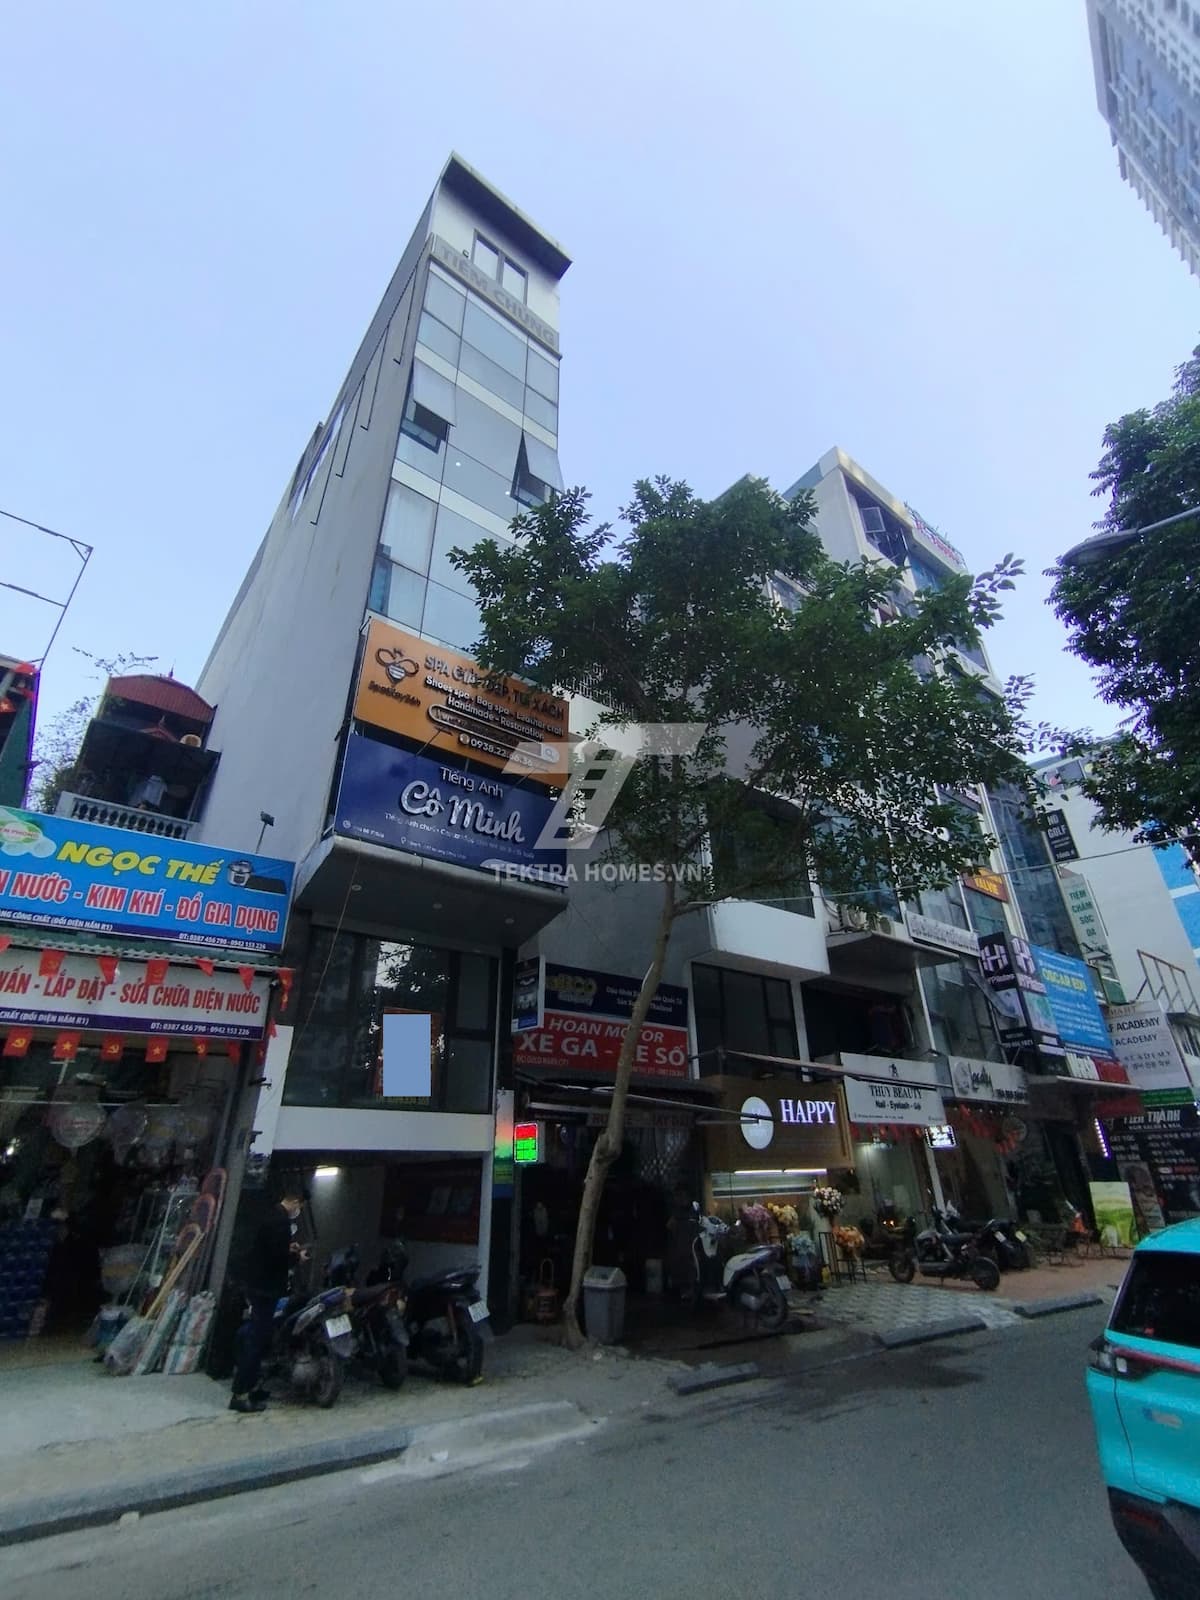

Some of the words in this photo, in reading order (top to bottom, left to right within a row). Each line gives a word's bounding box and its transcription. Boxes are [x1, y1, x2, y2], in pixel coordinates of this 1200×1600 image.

[425, 655, 449, 677] SPA
[425, 675, 452, 693] Shoes
[476, 695, 493, 710] Bag
[448, 695, 494, 720] Handmade
[500, 716, 545, 741] Restoration
[440, 766, 475, 792] Tiếng
[478, 781, 504, 798] Anh
[401, 780, 445, 816] Cô
[449, 795, 526, 843] Minh
[1047, 825, 1067, 839] GOLF
[57, 841, 162, 877] NGỌC
[165, 858, 225, 886] THẾ
[9, 872, 72, 904] NƯỚC
[84, 883, 128, 913] KIM
[128, 888, 167, 917] KHÍ
[204, 901, 233, 927] GIA
[235, 906, 280, 934] DỤNG
[0, 965, 32, 994] VẤN
[43, 968, 76, 998] LẮP
[76, 975, 108, 1005] ĐẶT
[152, 983, 191, 1008] CHỮA
[192, 987, 225, 1014] ĐIỆN
[225, 991, 262, 1015] NƯỚC
[548, 1018, 602, 1036] HOAN
[1115, 1033, 1158, 1047] ACADEMY
[1116, 1017, 1160, 1033] ACADEMY
[518, 1032, 554, 1053] XE
[560, 1036, 599, 1058] GA
[655, 1043, 686, 1067] SỐ
[893, 1086, 922, 1100] BEAUTY
[779, 1099, 837, 1125] HAPPY
